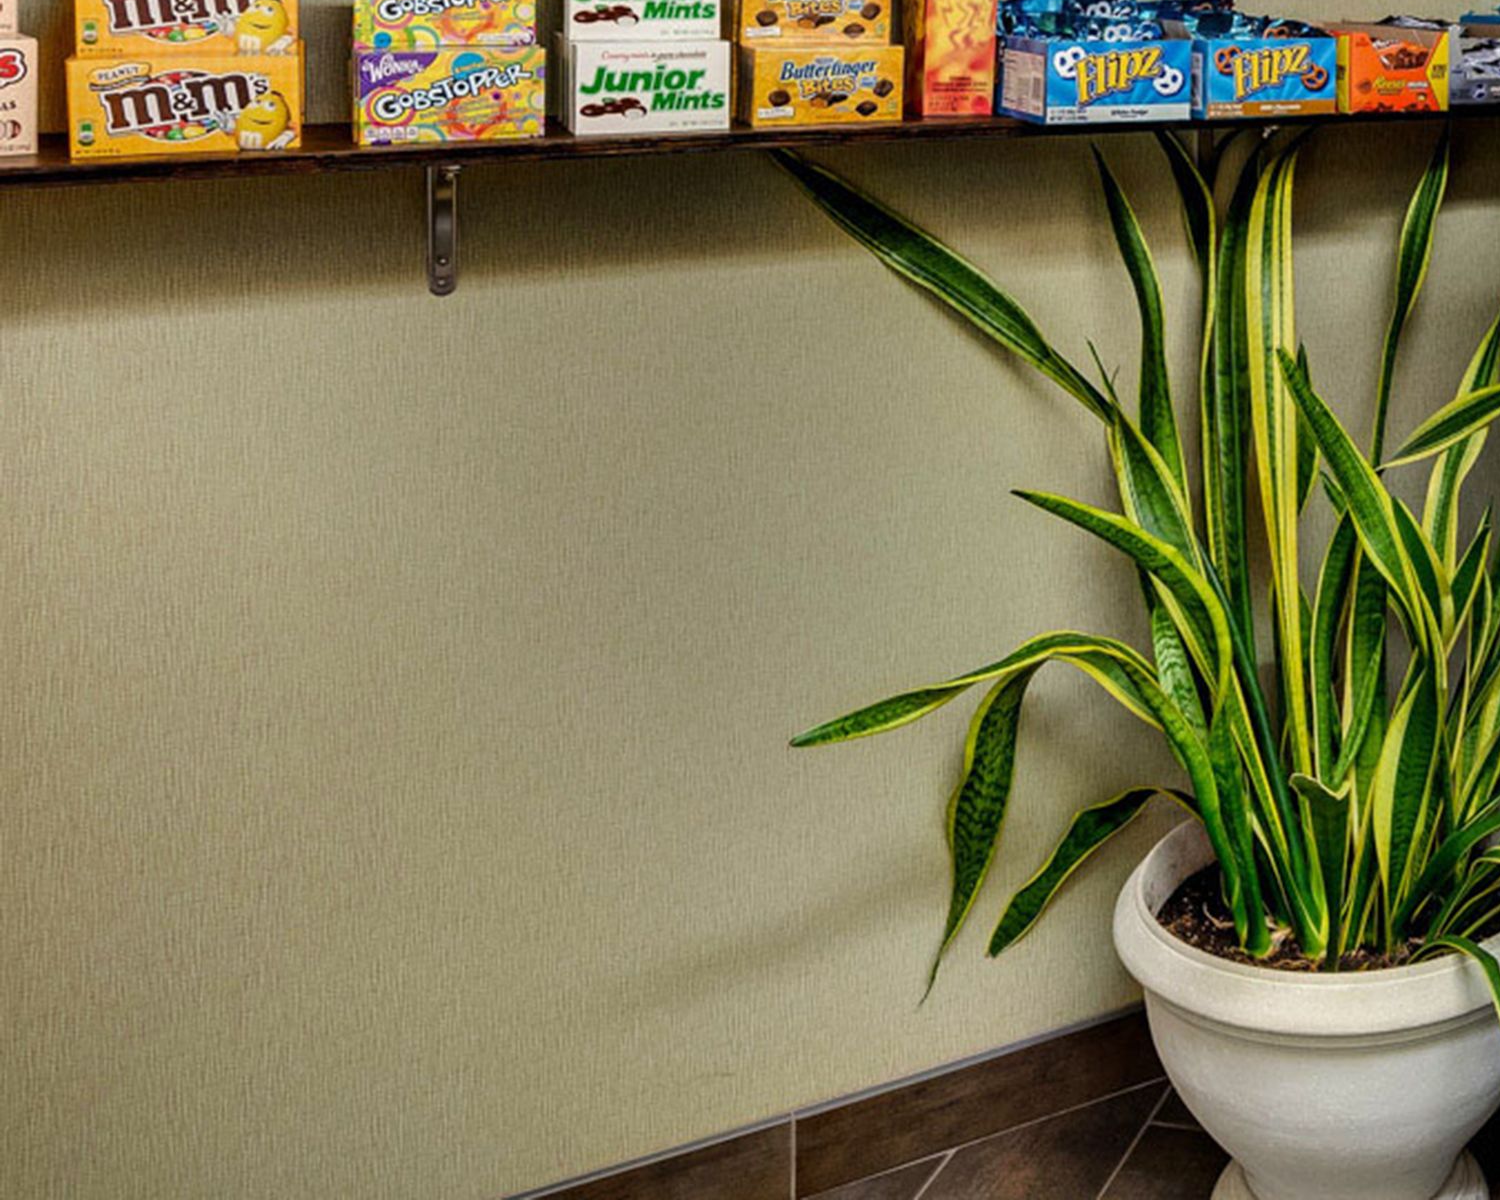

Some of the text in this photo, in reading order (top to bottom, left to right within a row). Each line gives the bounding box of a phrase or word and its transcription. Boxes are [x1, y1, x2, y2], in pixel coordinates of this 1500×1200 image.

[643, 0, 716, 20] Mints
[97, 65, 141, 82] PEANUT
[580, 63, 706, 94] Junior
[780, 60, 877, 82] Butterfinger
[1074, 45, 1163, 107] Flipz
[1234, 44, 1312, 100] Flipz
[652, 91, 726, 112] Mints
